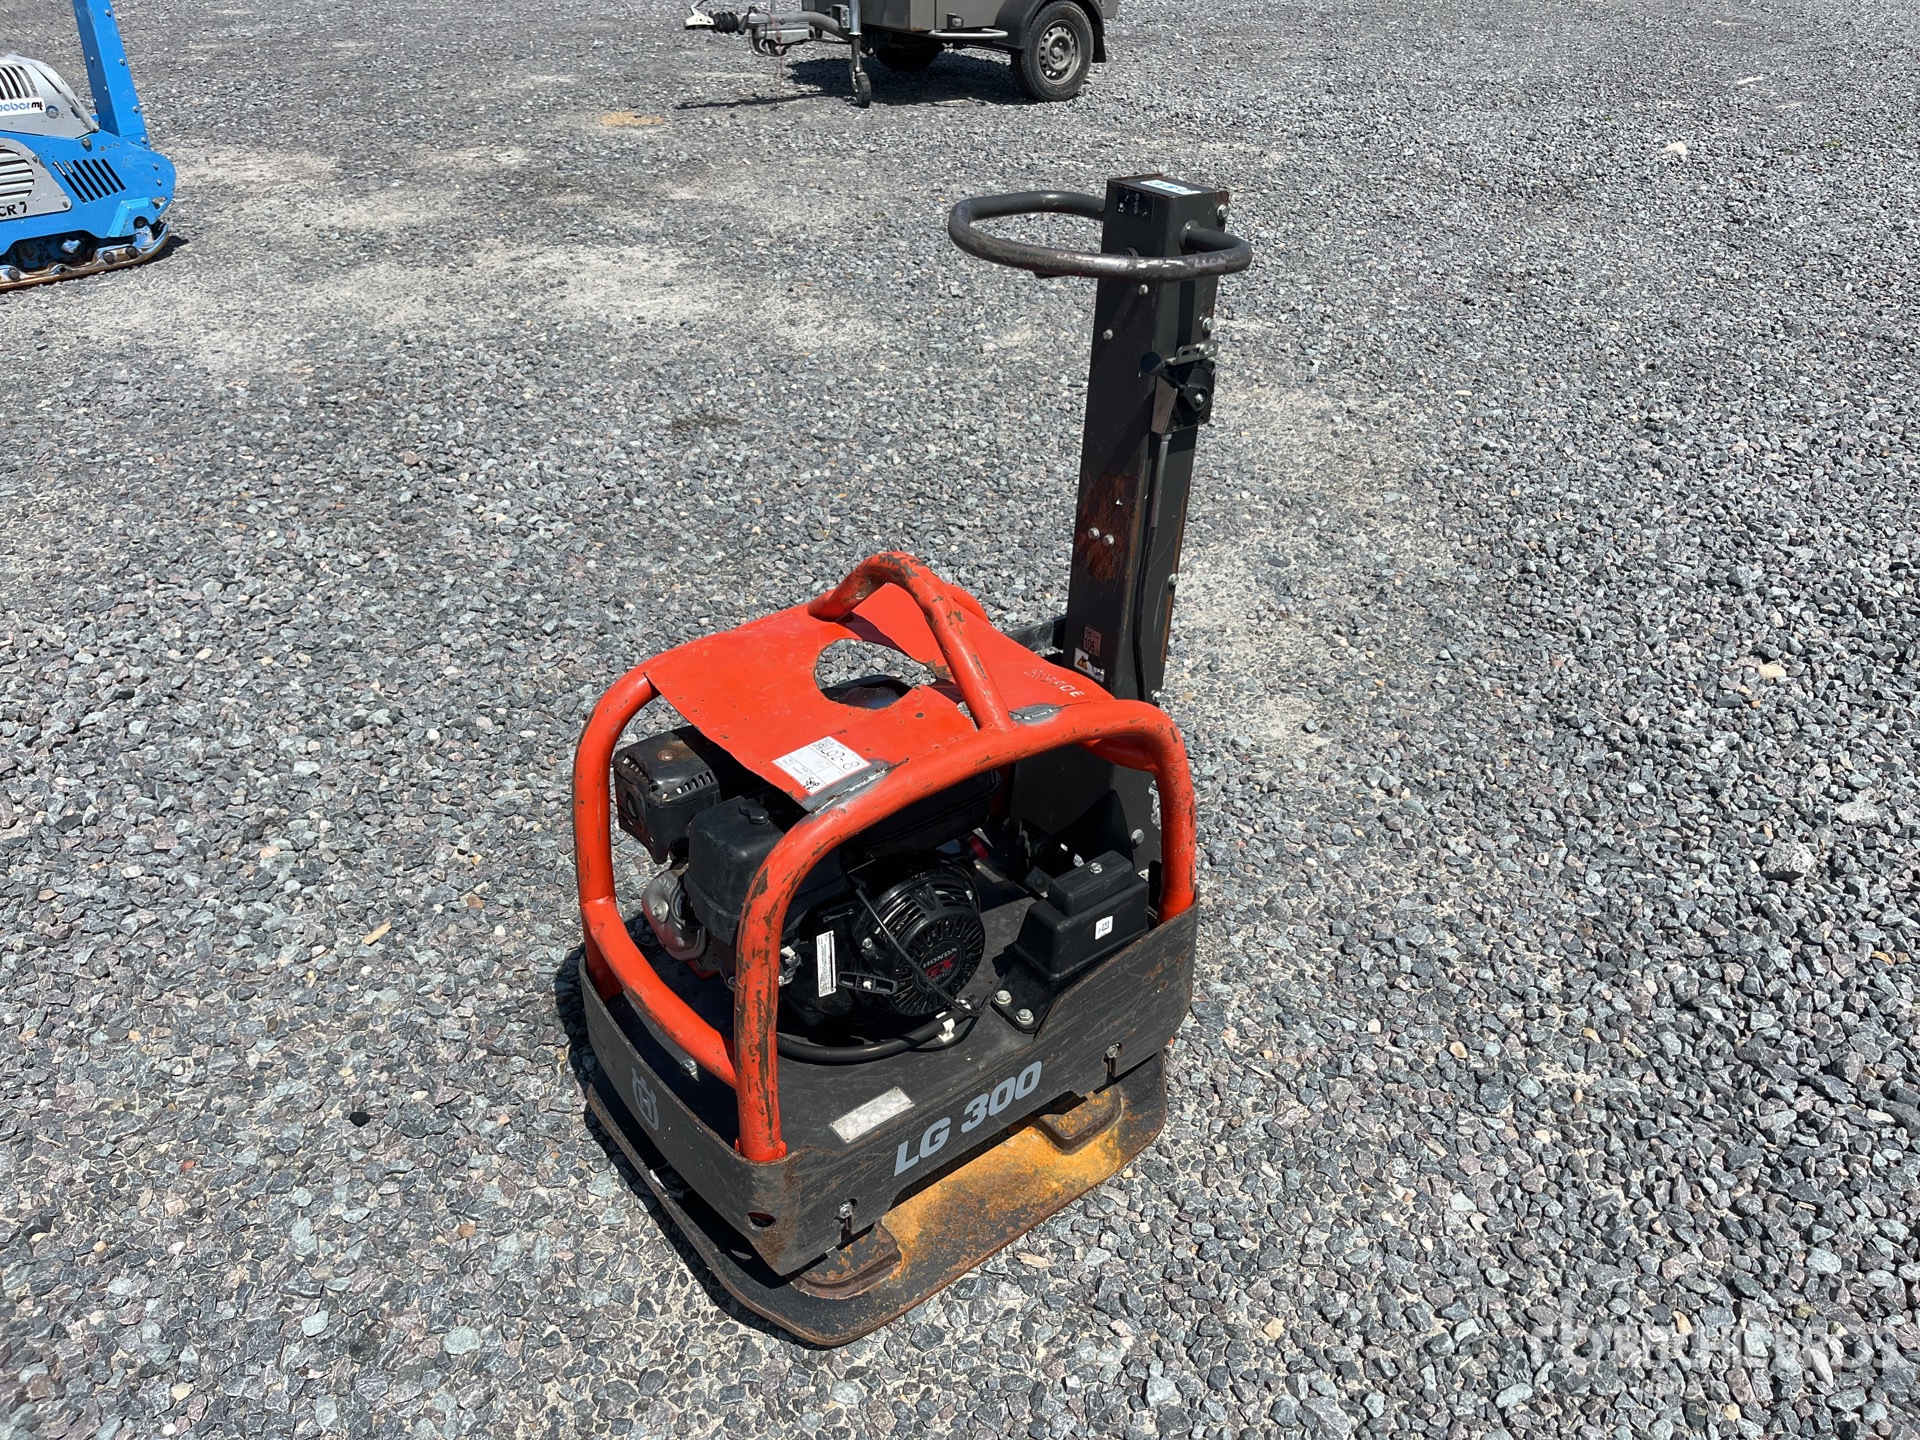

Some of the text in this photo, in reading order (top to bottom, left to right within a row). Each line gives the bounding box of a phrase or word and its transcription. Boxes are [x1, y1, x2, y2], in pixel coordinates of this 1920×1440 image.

[922, 947, 958, 969] HONDA
[894, 1117, 951, 1177] LG
[960, 1060, 1043, 1133] 300
